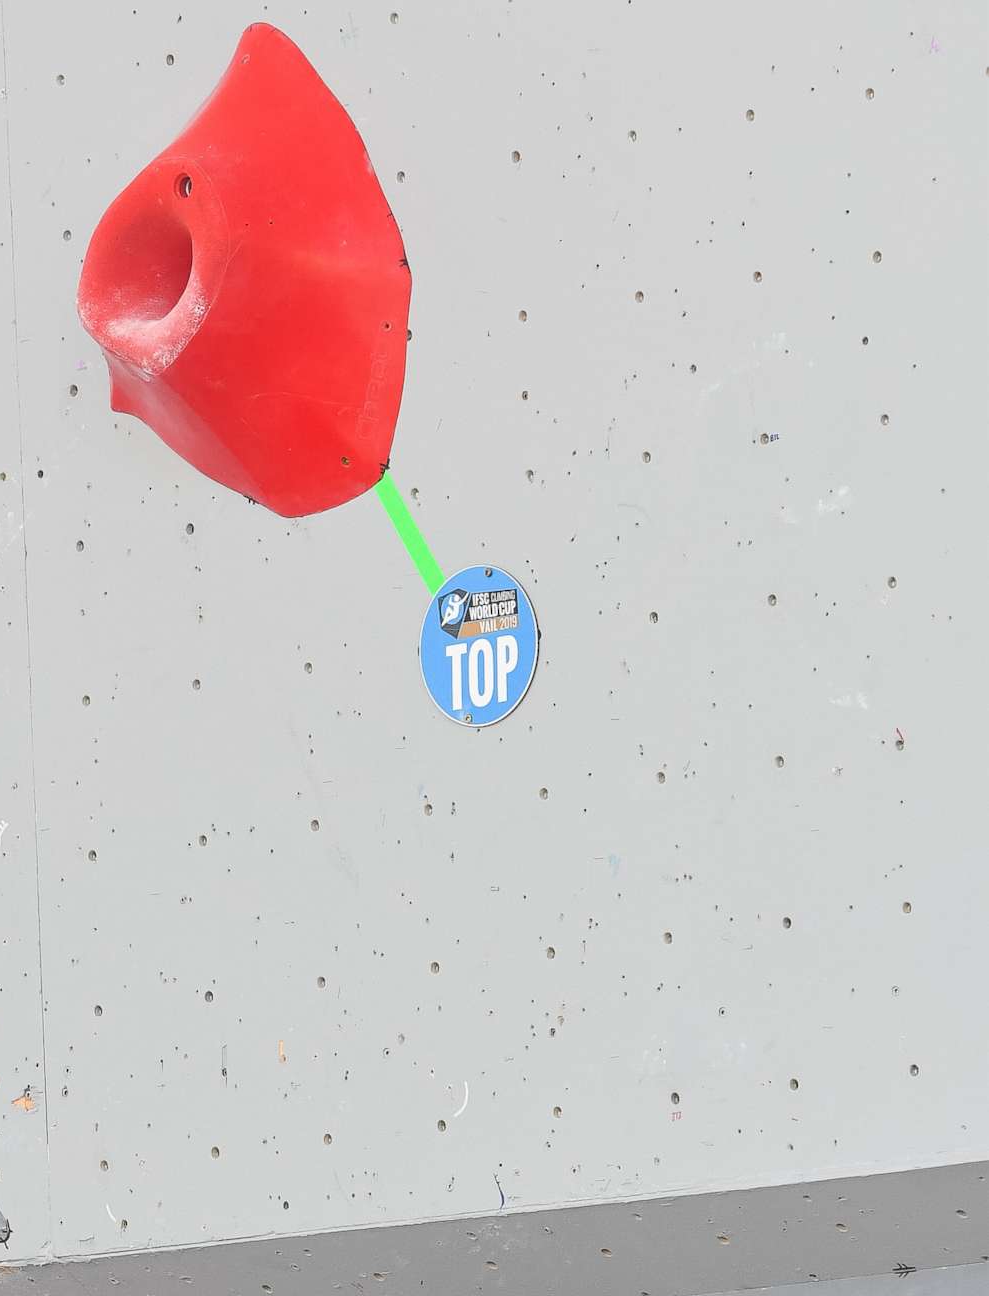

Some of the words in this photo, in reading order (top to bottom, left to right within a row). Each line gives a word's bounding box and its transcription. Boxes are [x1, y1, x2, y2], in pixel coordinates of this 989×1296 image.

[471, 592, 490, 606] IFSC
[469, 603, 498, 620] WORLD
[498, 600, 516, 616] CUP
[479, 618, 497, 633] VAIL
[498, 615, 517, 630] 2019
[445, 635, 519, 711] TOP
